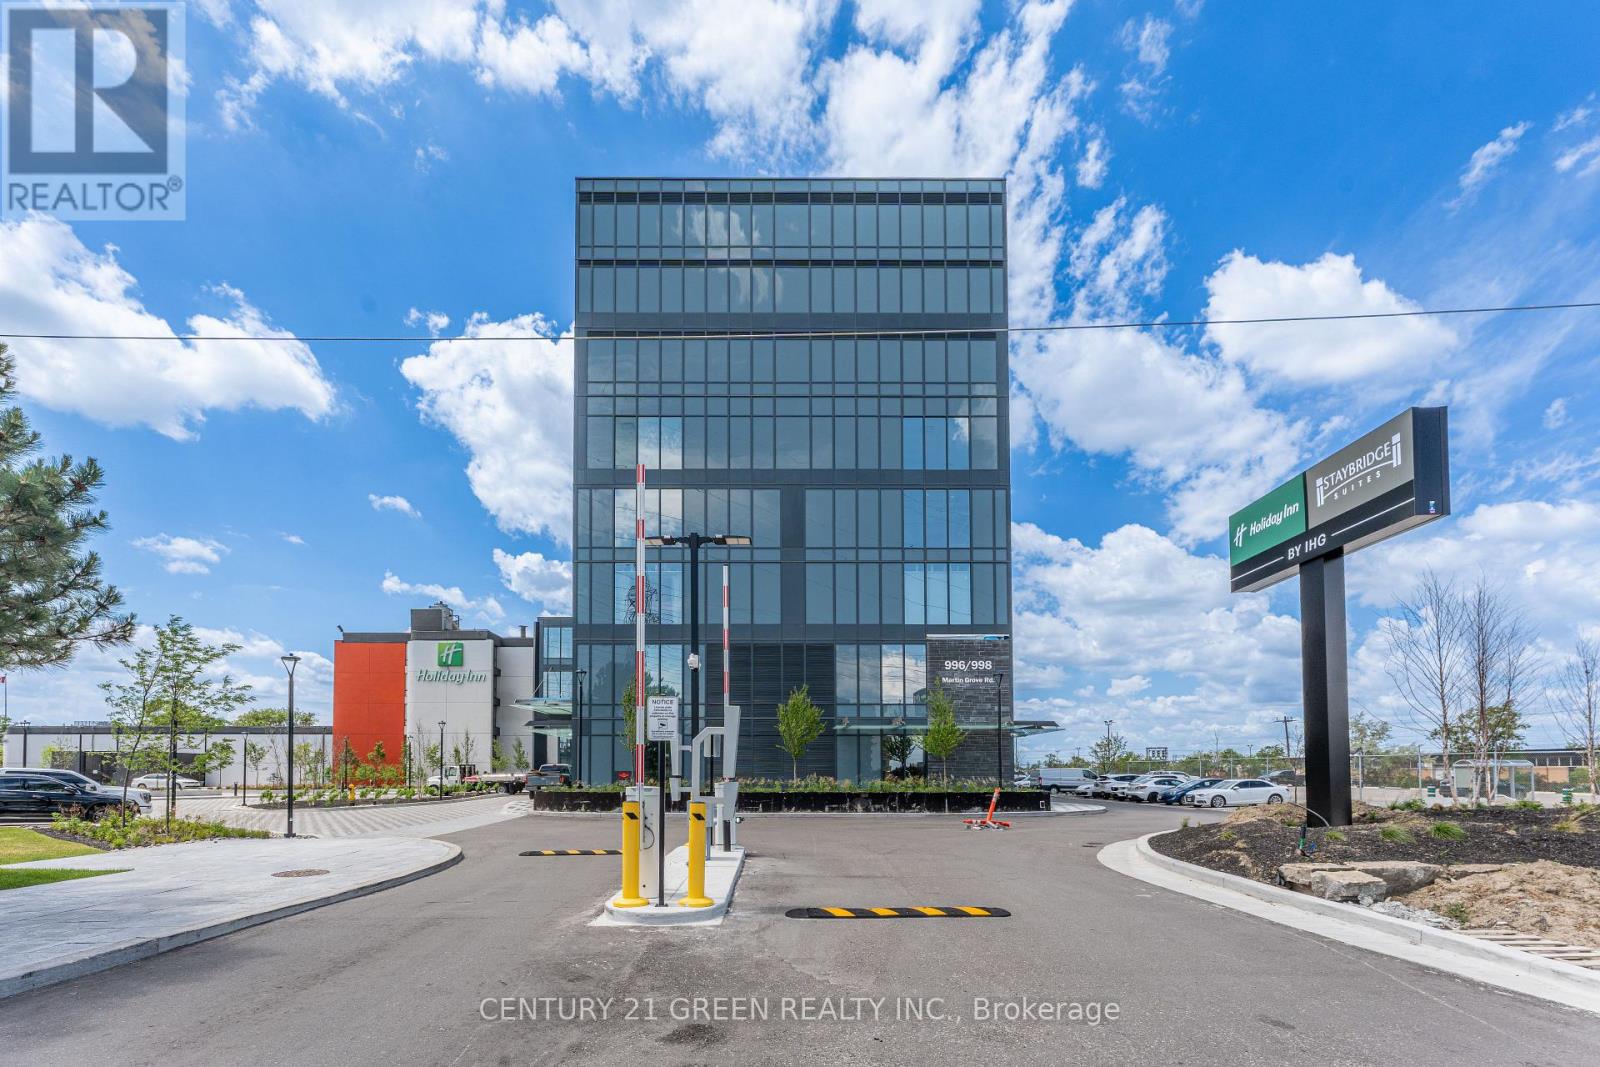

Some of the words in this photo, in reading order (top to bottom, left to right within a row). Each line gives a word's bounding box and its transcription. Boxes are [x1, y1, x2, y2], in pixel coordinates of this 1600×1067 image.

[1323, 441, 1391, 490] STAYBRIDGE
[1334, 471, 1381, 500] SUITES
[1287, 543, 1302, 560] BY
[1305, 533, 1327, 553] IHG
[944, 660, 992, 671] 996/998
